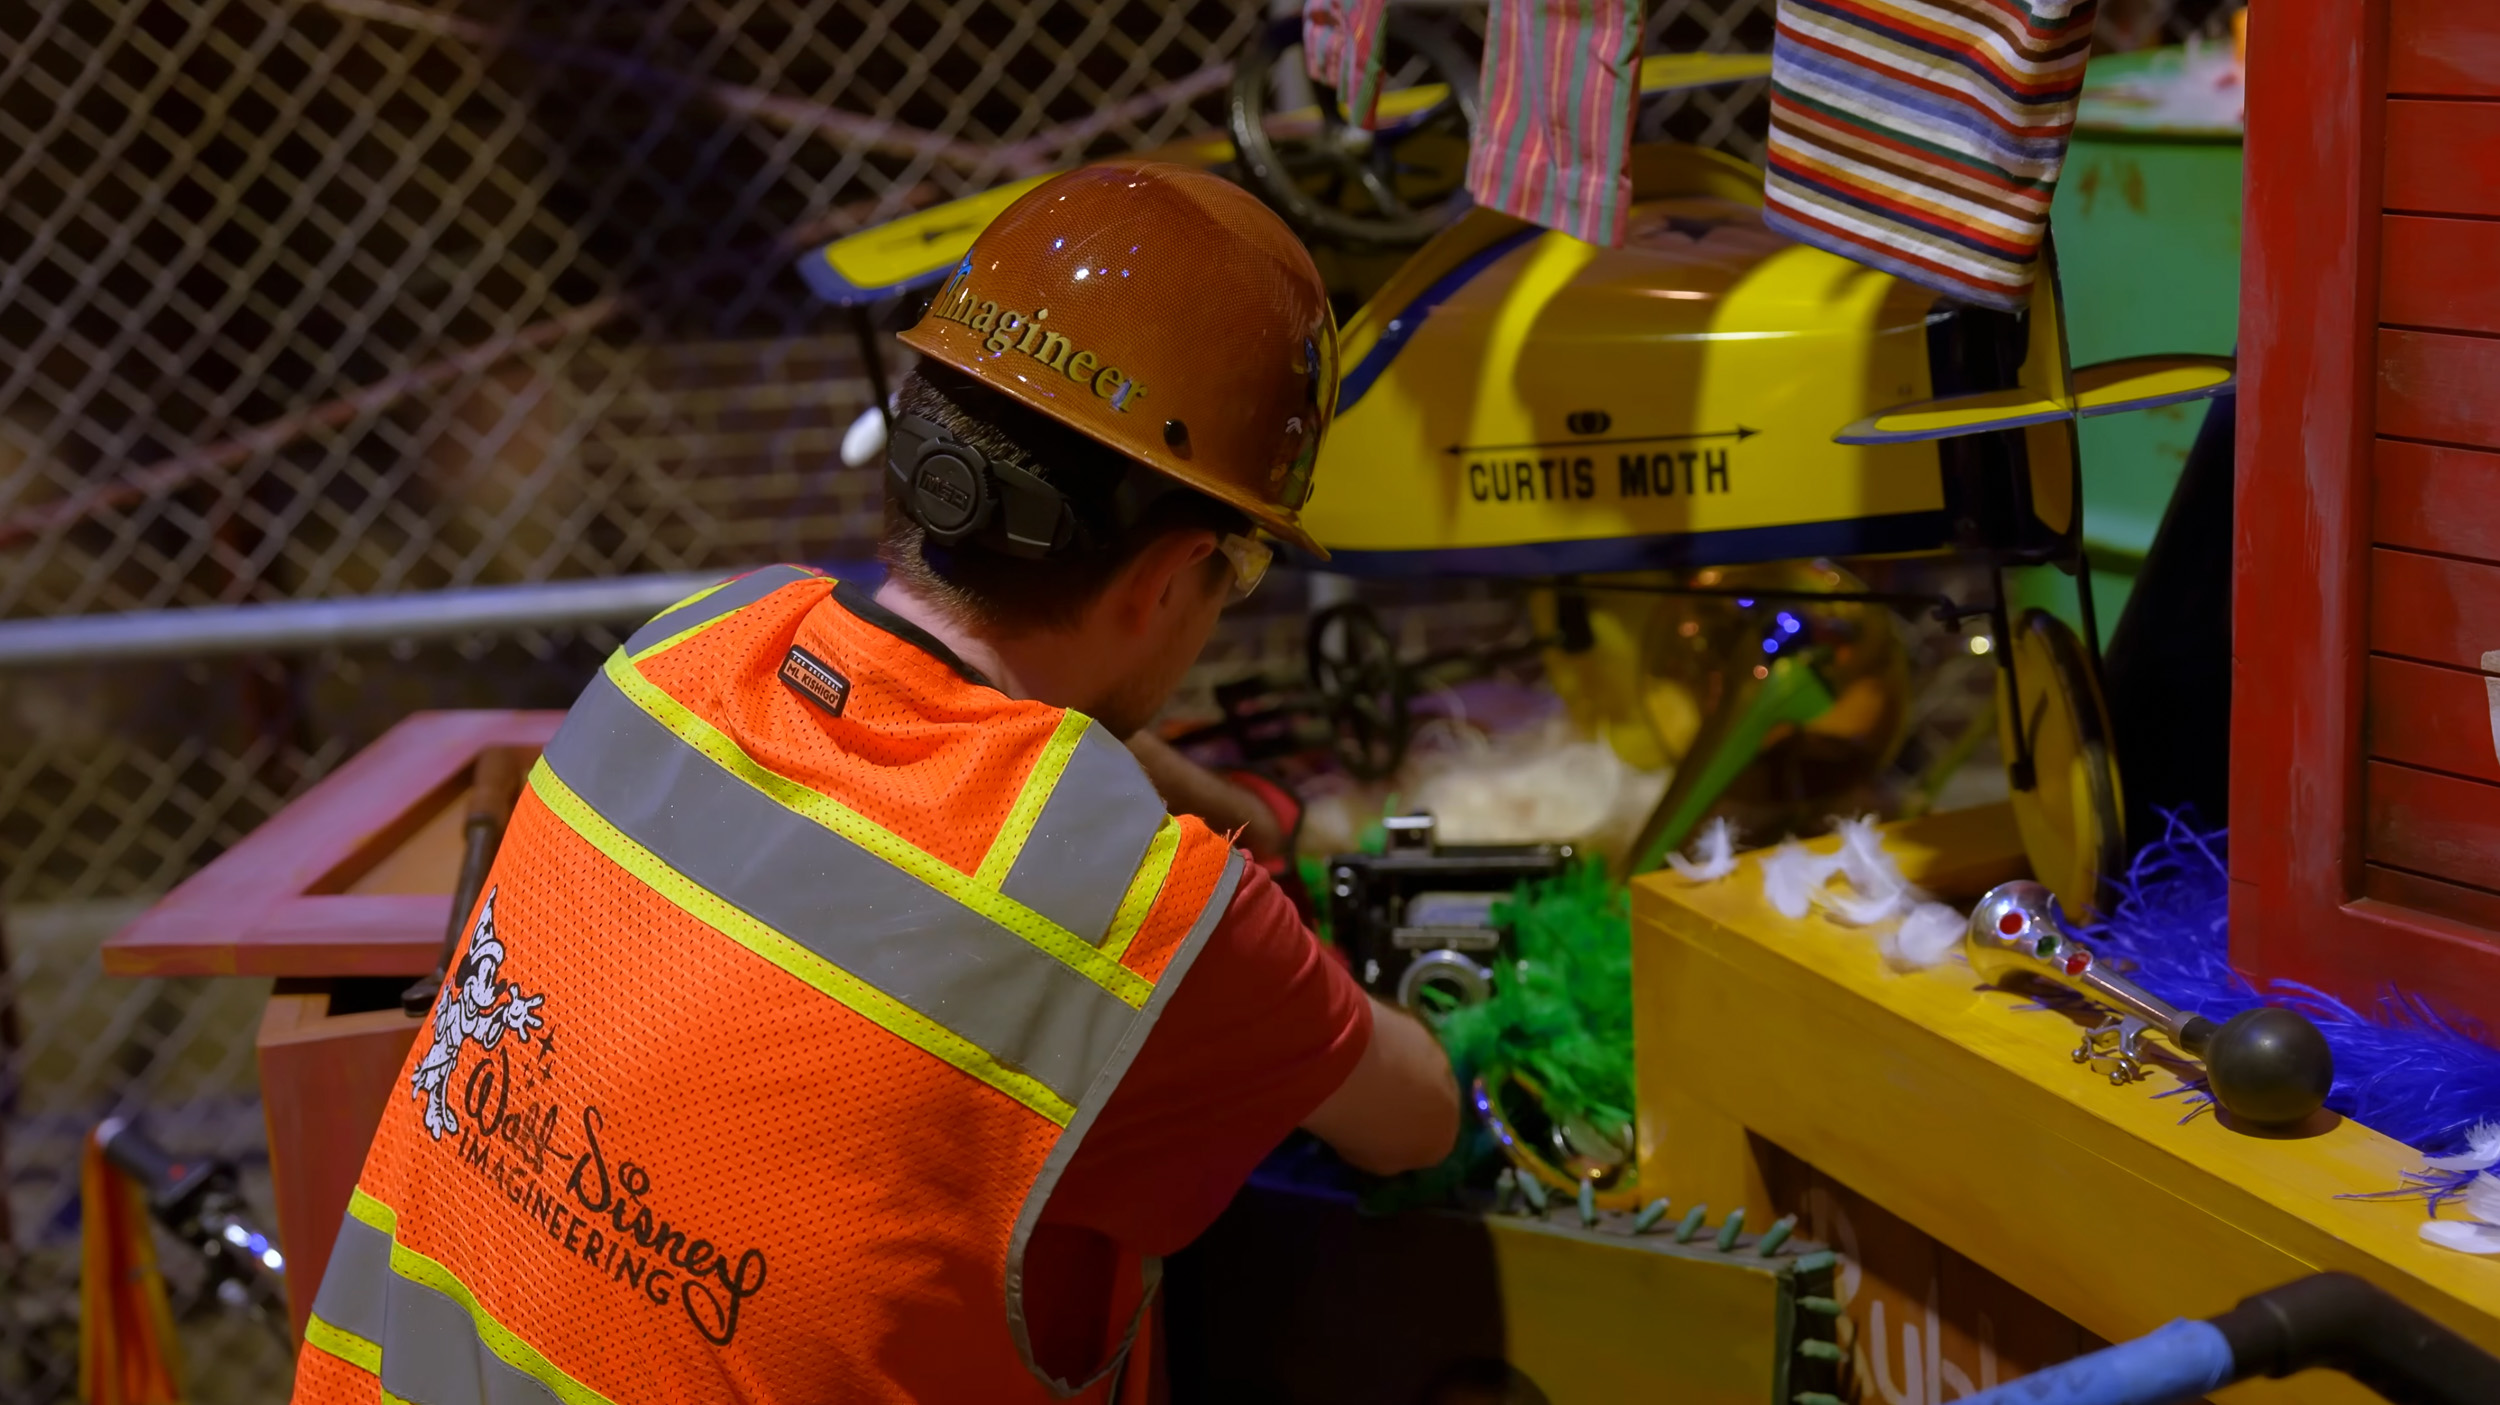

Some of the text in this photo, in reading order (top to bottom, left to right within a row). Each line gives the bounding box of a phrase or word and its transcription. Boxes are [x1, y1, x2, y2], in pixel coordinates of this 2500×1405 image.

[932, 273, 1149, 413] Imagineer
[1469, 449, 1729, 501] CURTIS MOTH
[786, 663, 800, 679] ML
[457, 1125, 676, 1306] IMAGINEERING
[465, 1045, 767, 1347] Walt Disney
